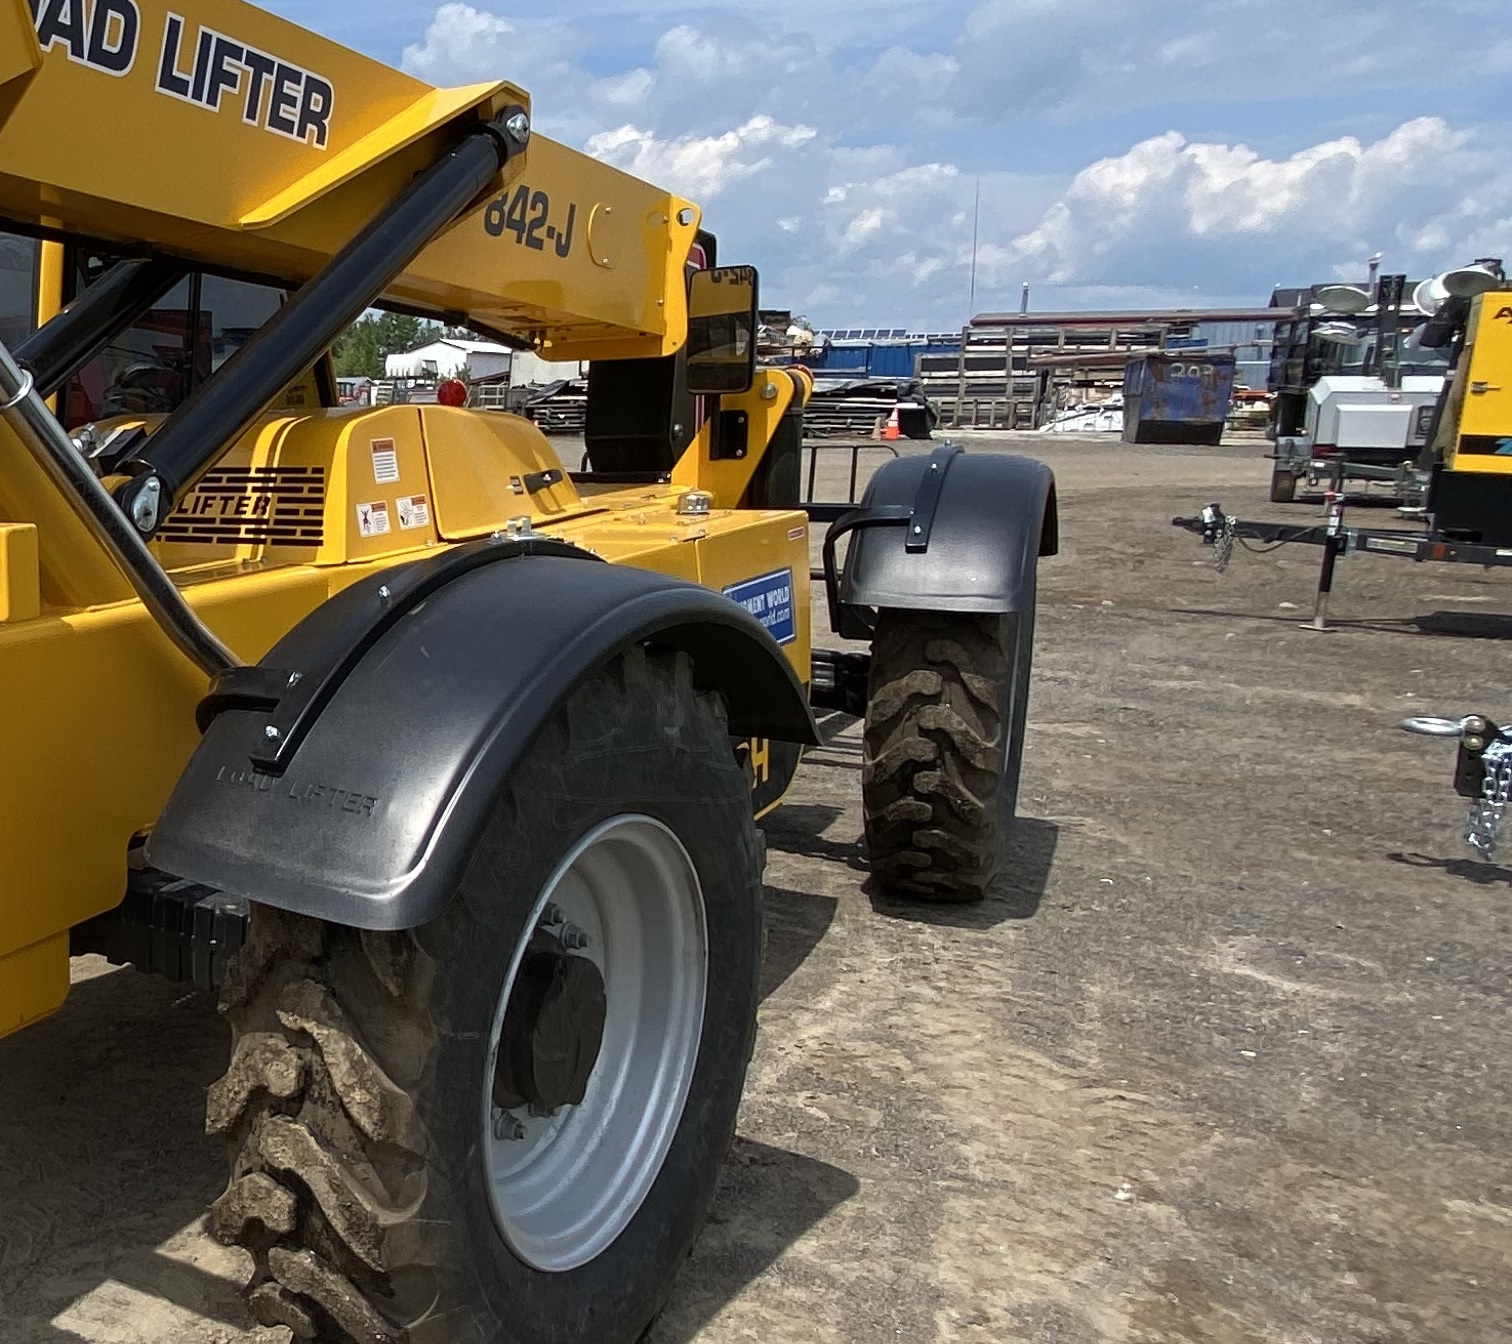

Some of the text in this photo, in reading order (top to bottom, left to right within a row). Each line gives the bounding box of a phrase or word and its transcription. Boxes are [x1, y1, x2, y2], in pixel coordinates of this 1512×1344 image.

[154, 11, 335, 152] LIFTER
[484, 184, 576, 259] 842-J
[175, 495, 272, 516] LIFTER
[766, 585, 790, 608] WORLD
[288, 782, 379, 817] LIFTER
